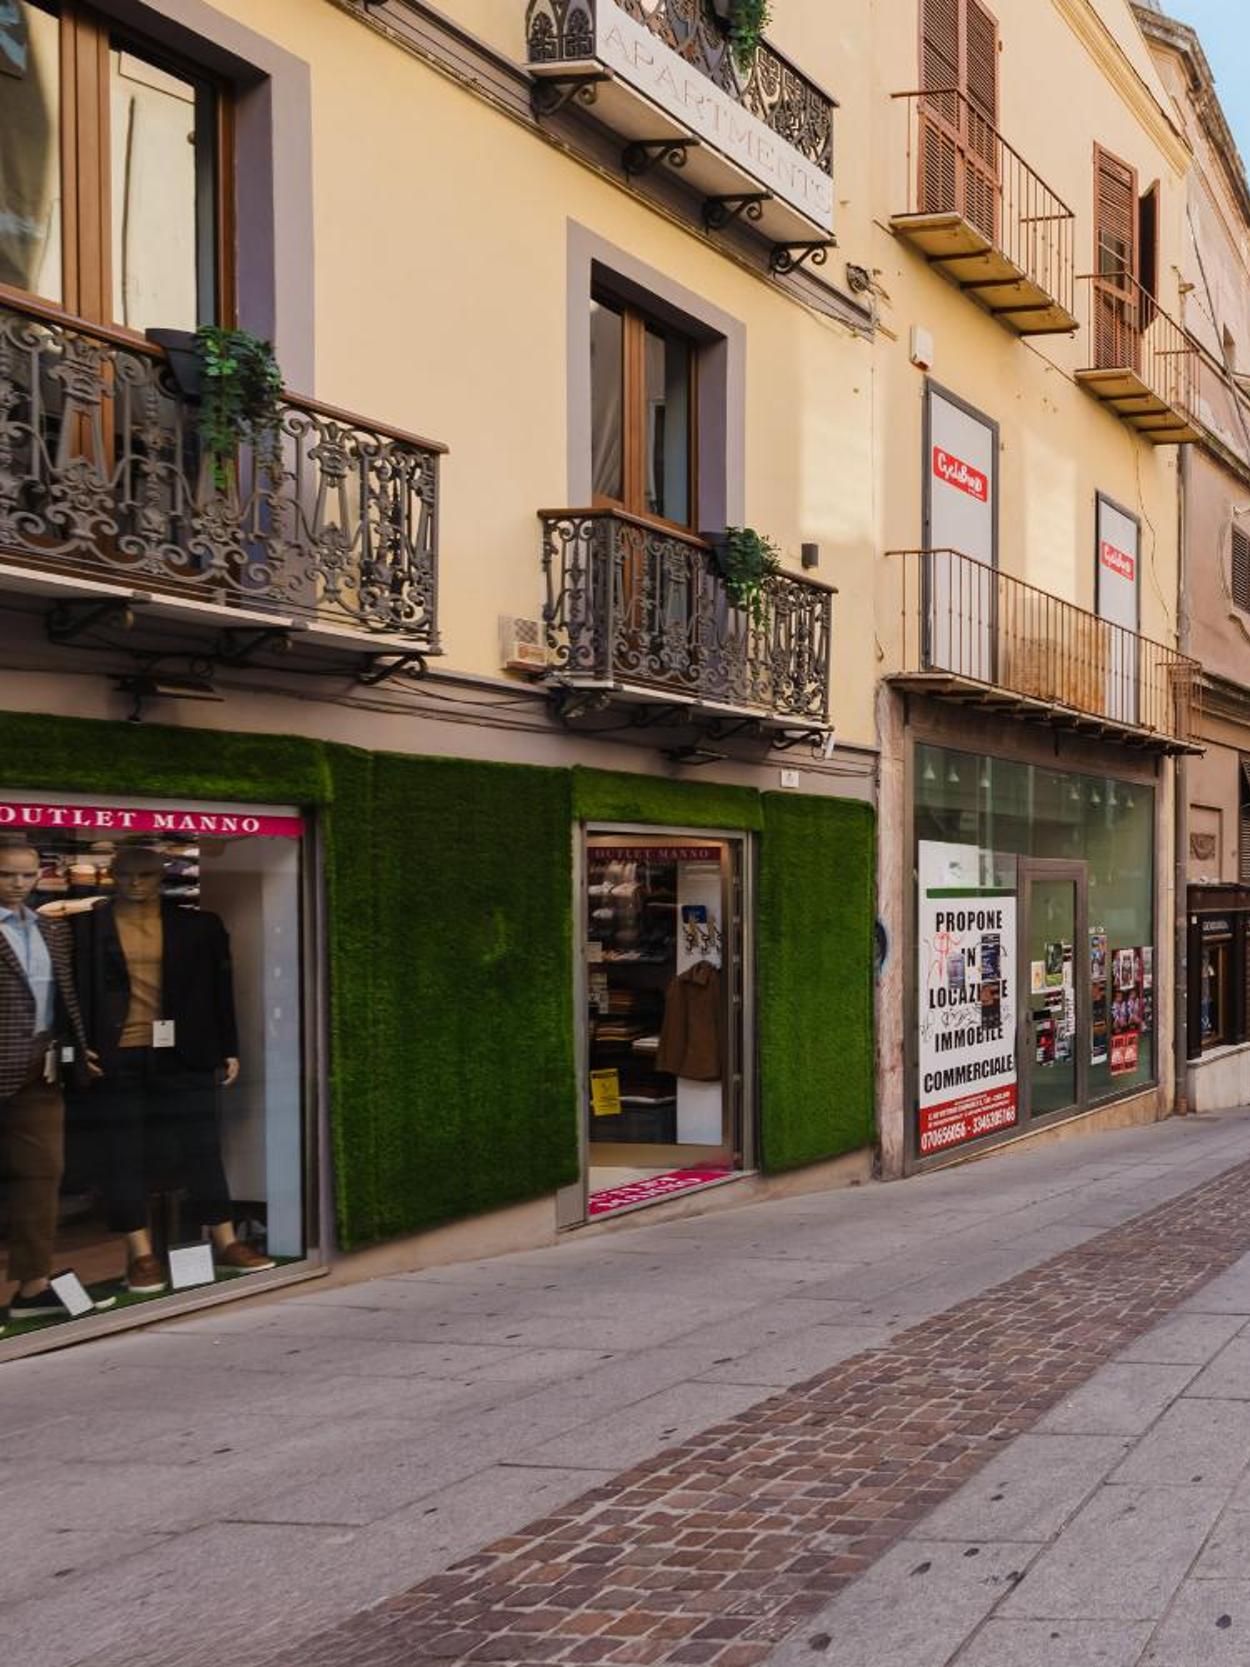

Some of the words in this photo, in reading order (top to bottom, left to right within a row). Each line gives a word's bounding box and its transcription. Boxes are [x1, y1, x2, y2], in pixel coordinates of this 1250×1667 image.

[605, 23, 832, 215] APARTMENTS
[0, 806, 136, 828] OUTLET
[152, 814, 260, 833] MANNO
[936, 910, 1003, 932] PROPONE
[929, 980, 1008, 1009] LOCAZIE
[935, 1021, 1004, 1053] IMMOBILE
[924, 1054, 1013, 1093] COMMERCIALE
